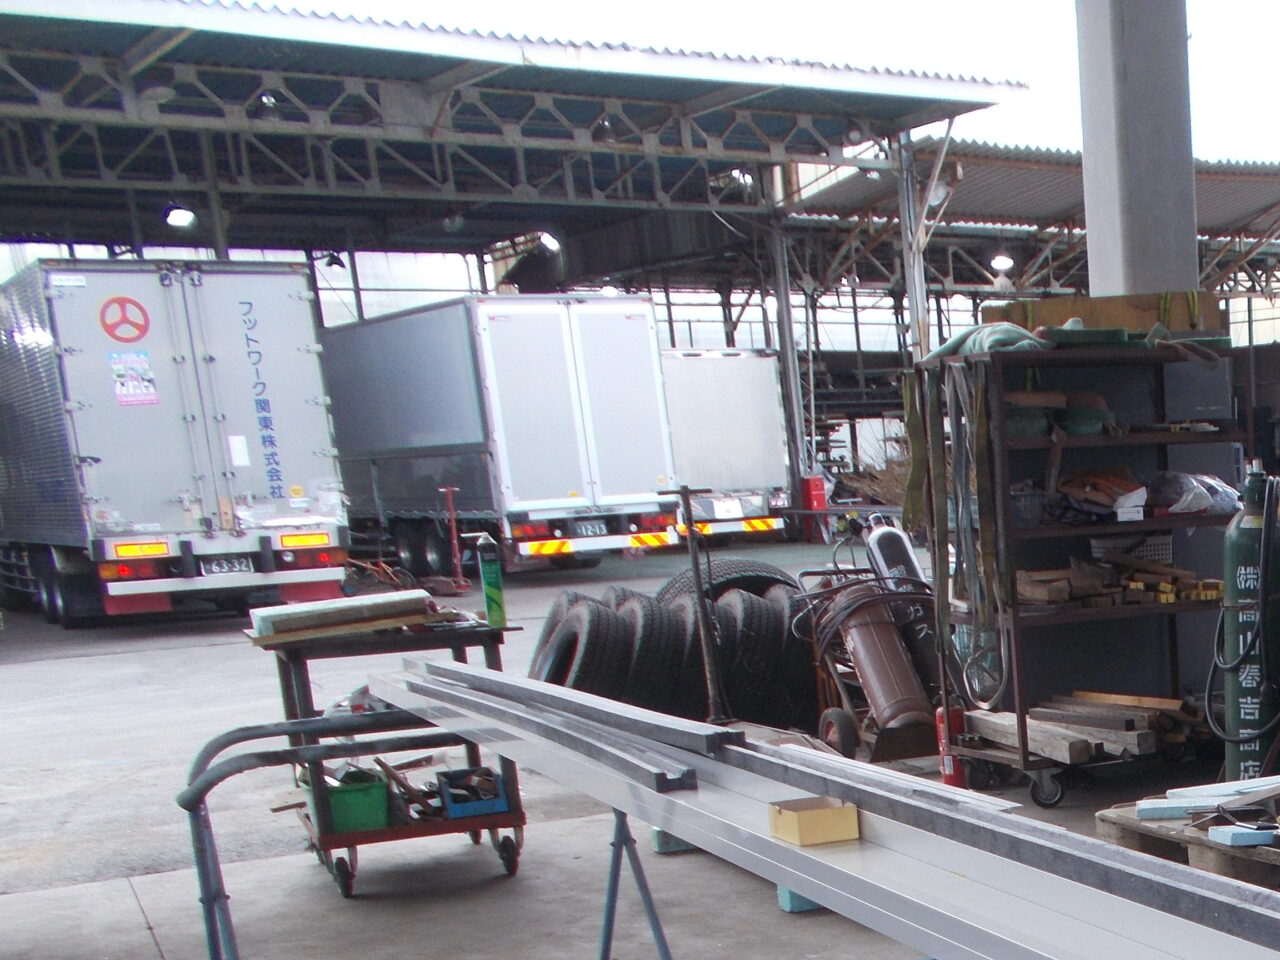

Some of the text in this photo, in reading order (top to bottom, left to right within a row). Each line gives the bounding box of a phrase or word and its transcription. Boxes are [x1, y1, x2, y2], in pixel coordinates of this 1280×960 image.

[238, 301, 285, 499] フットワーク関東株式会社
[211, 558, 249, 573] 63-32
